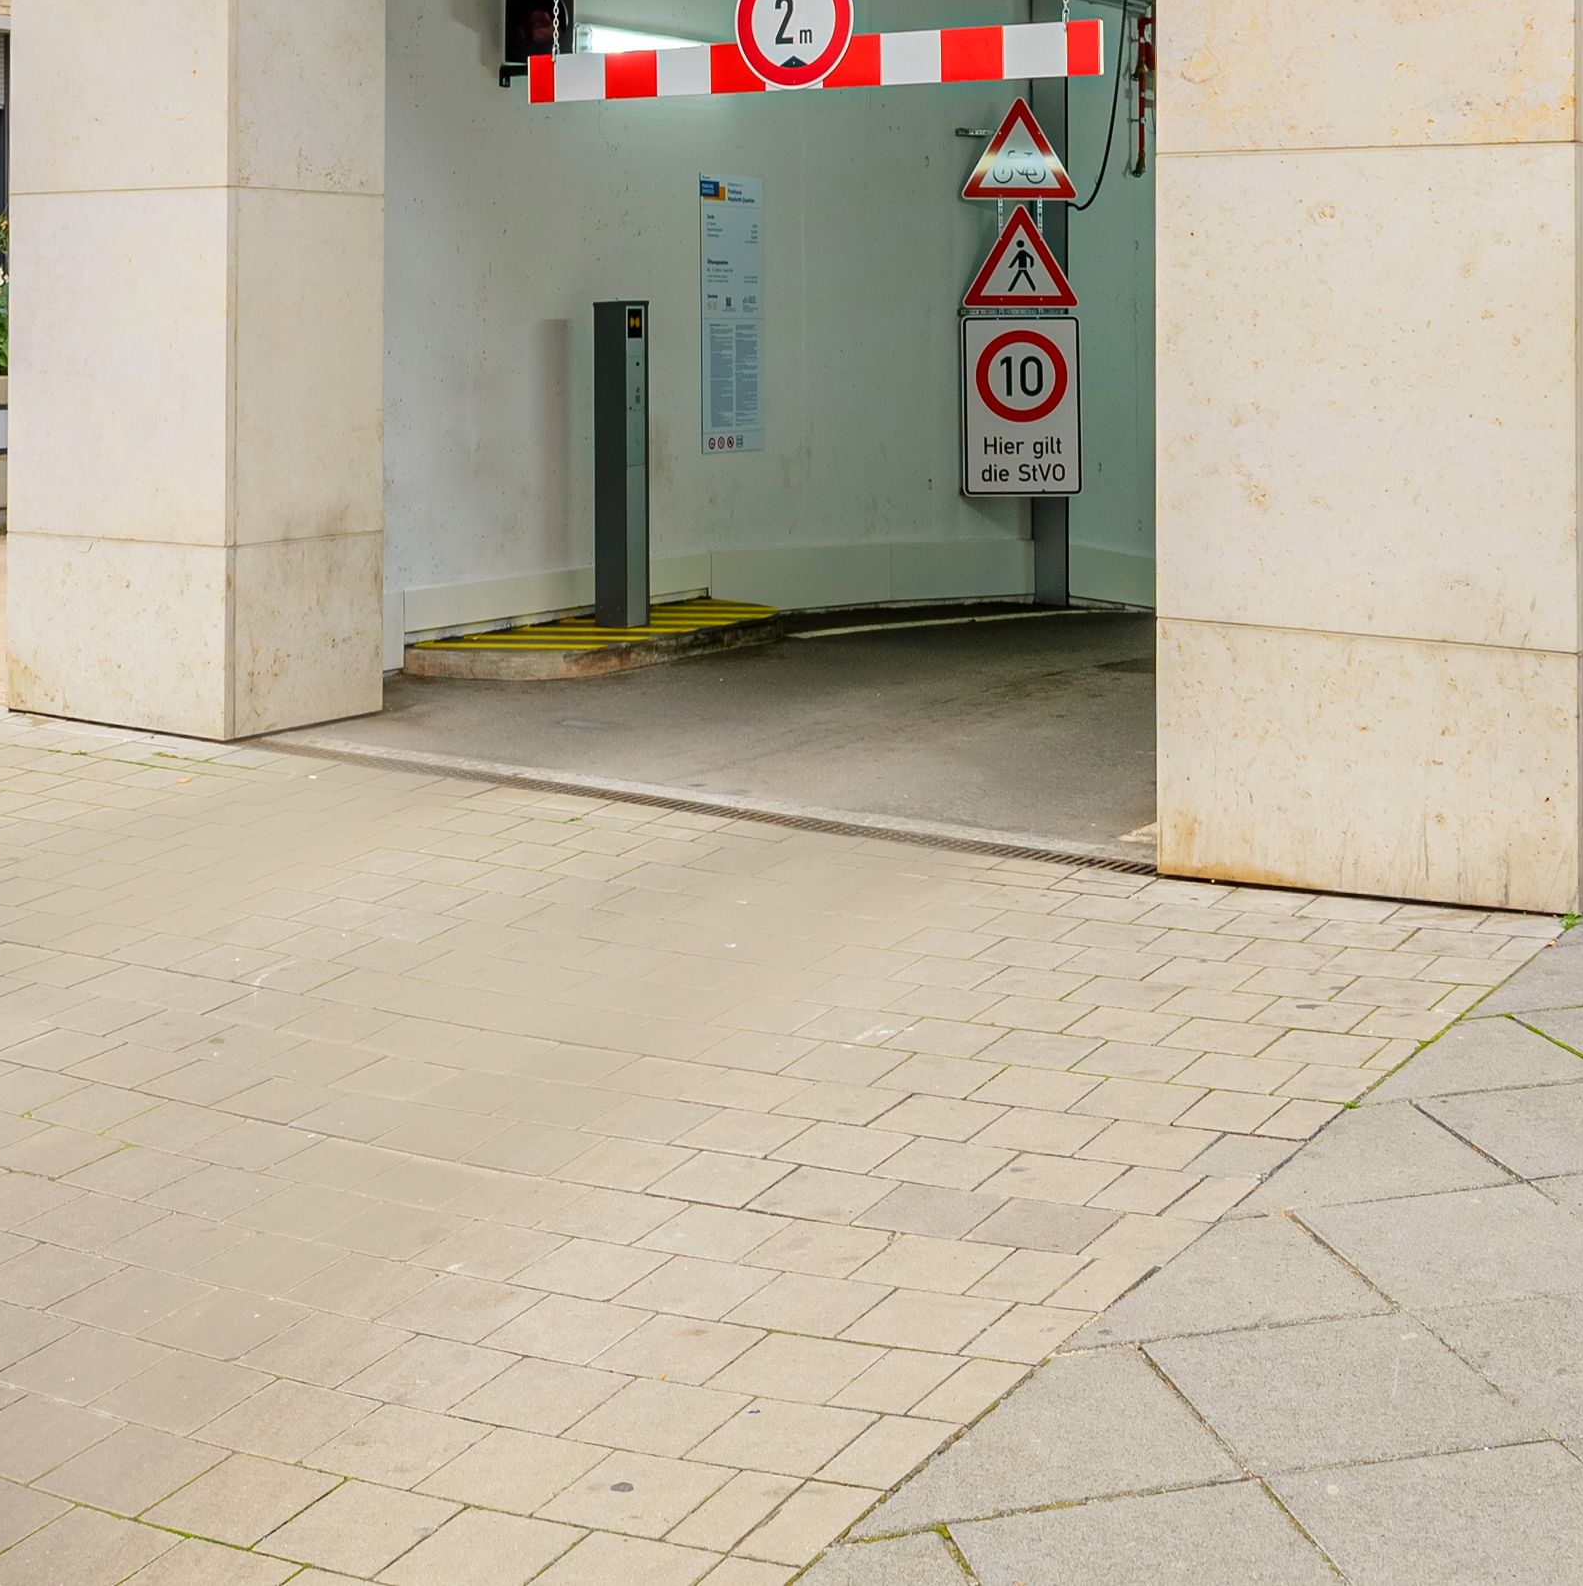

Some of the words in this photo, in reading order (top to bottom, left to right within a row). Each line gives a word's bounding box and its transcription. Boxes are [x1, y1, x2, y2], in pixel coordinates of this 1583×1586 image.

[999, 355, 1044, 397] 10
[983, 436, 1024, 455] Hier
[1032, 436, 1062, 459] gilt
[981, 464, 1010, 482] die
[1018, 463, 1066, 482] StVO
